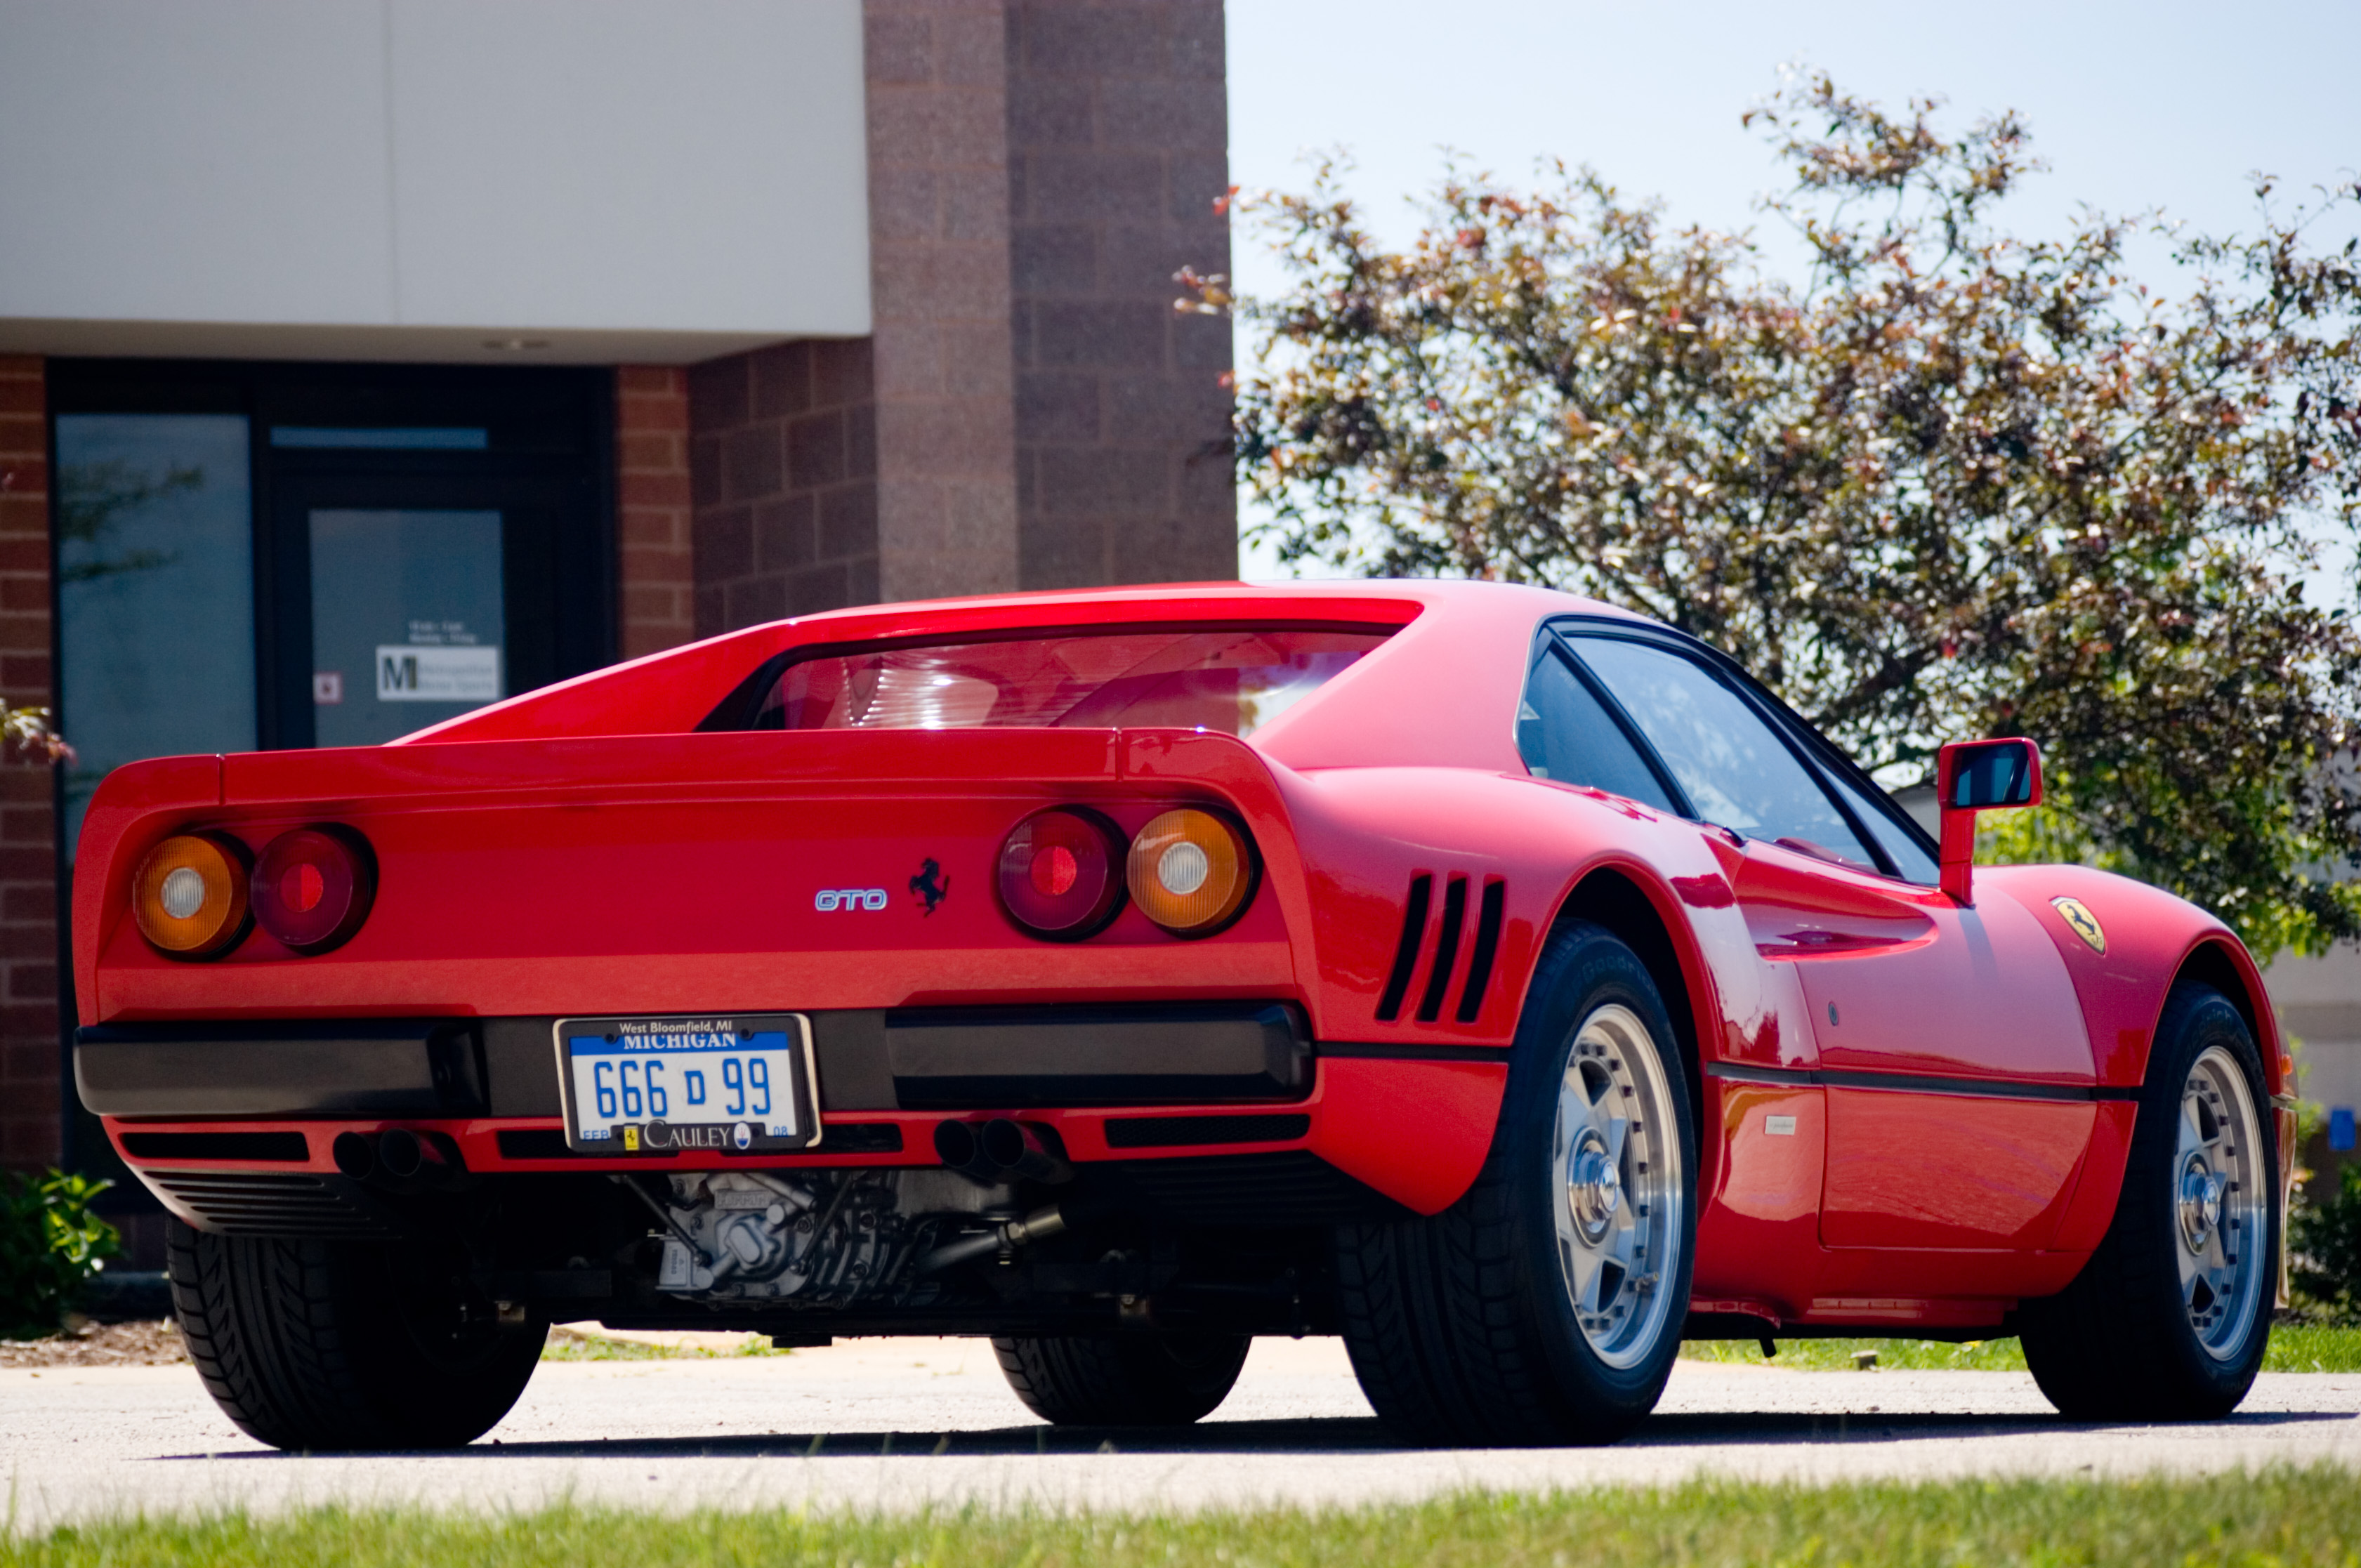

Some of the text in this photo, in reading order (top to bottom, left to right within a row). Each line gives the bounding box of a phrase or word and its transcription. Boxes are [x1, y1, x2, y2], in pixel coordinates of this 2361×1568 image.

[815, 889, 887, 911] GTO
[619, 1020, 732, 1034] West Bloomfield, MI
[624, 1033, 736, 1049] MICHIGAN
[593, 1058, 771, 1118] 666 D 99
[644, 1119, 730, 1147] CAULEY
